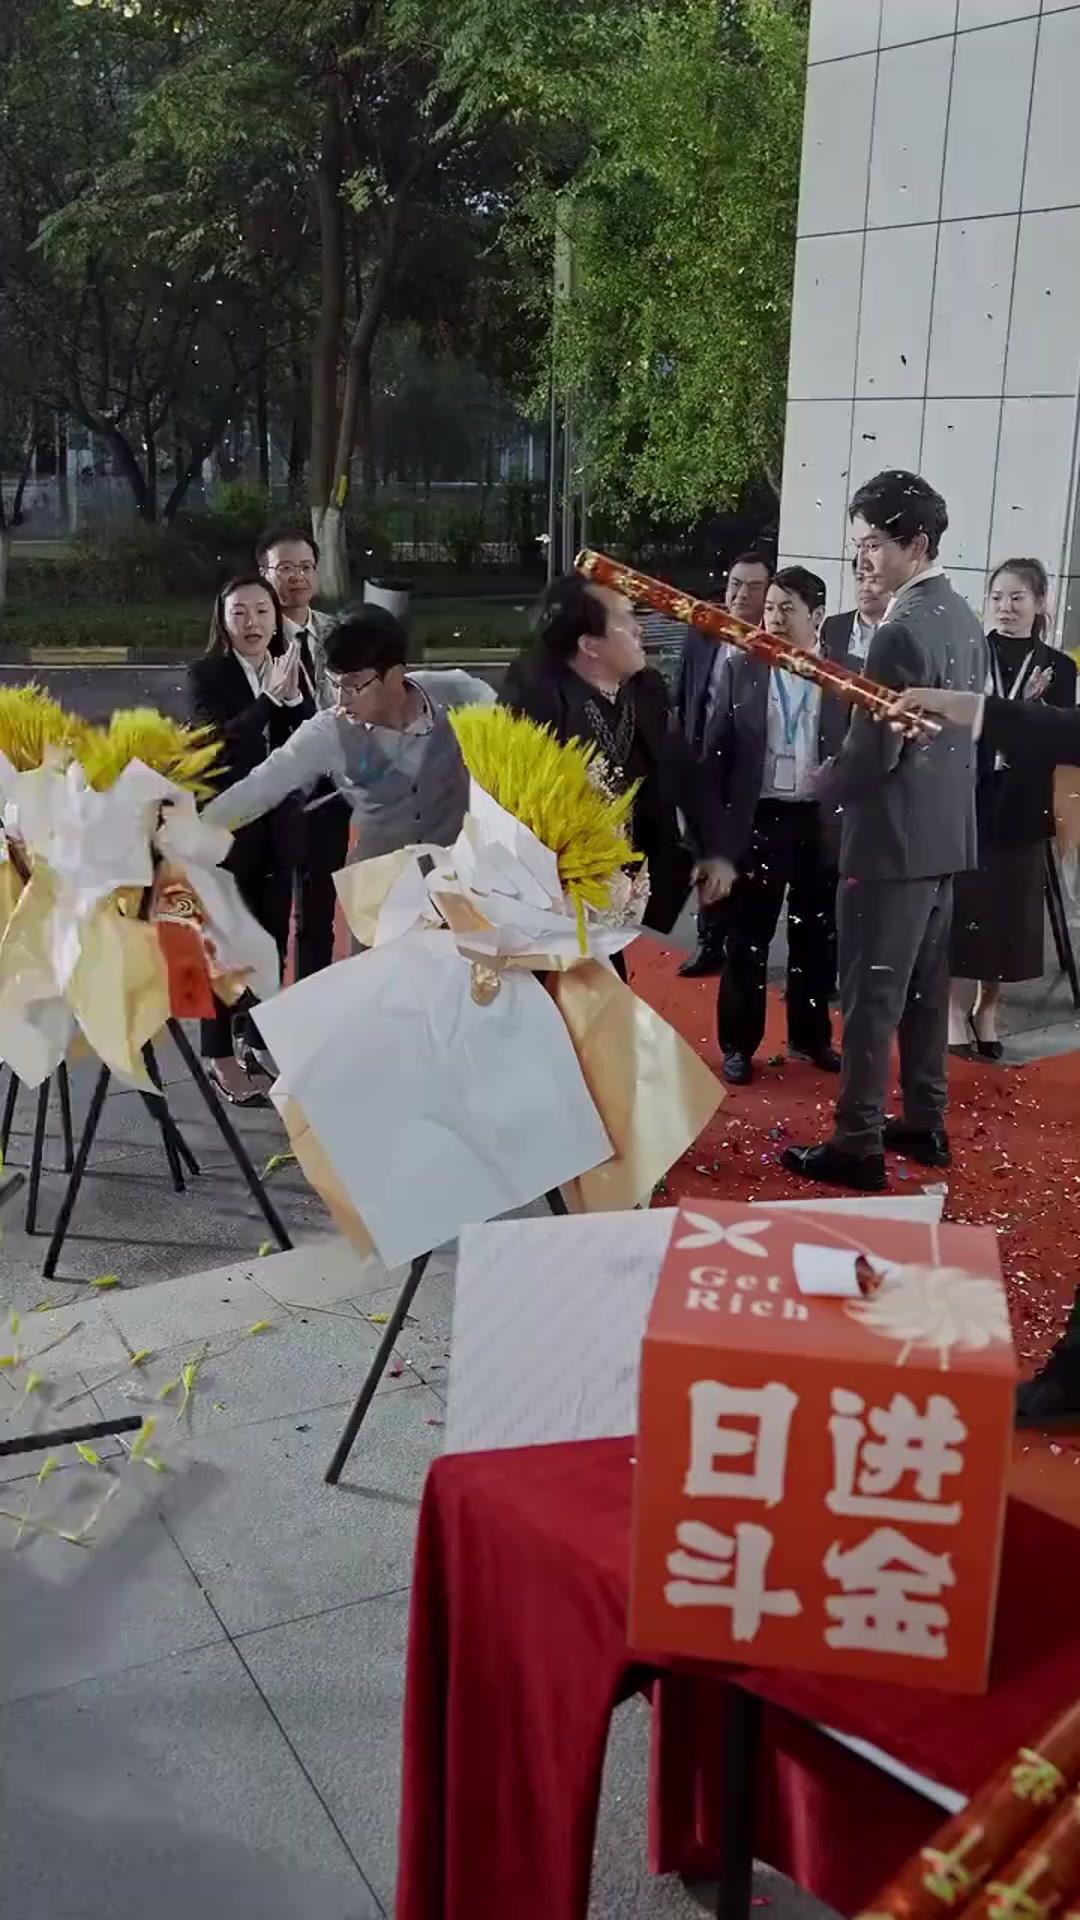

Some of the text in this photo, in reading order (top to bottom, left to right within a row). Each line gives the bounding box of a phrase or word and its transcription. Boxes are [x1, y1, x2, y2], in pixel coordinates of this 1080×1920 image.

[685, 1286, 809, 1321] Rich
[689, 1265, 781, 1293] Get
[683, 1379, 968, 1525] 日进
[663, 1520, 956, 1659] 斗金
